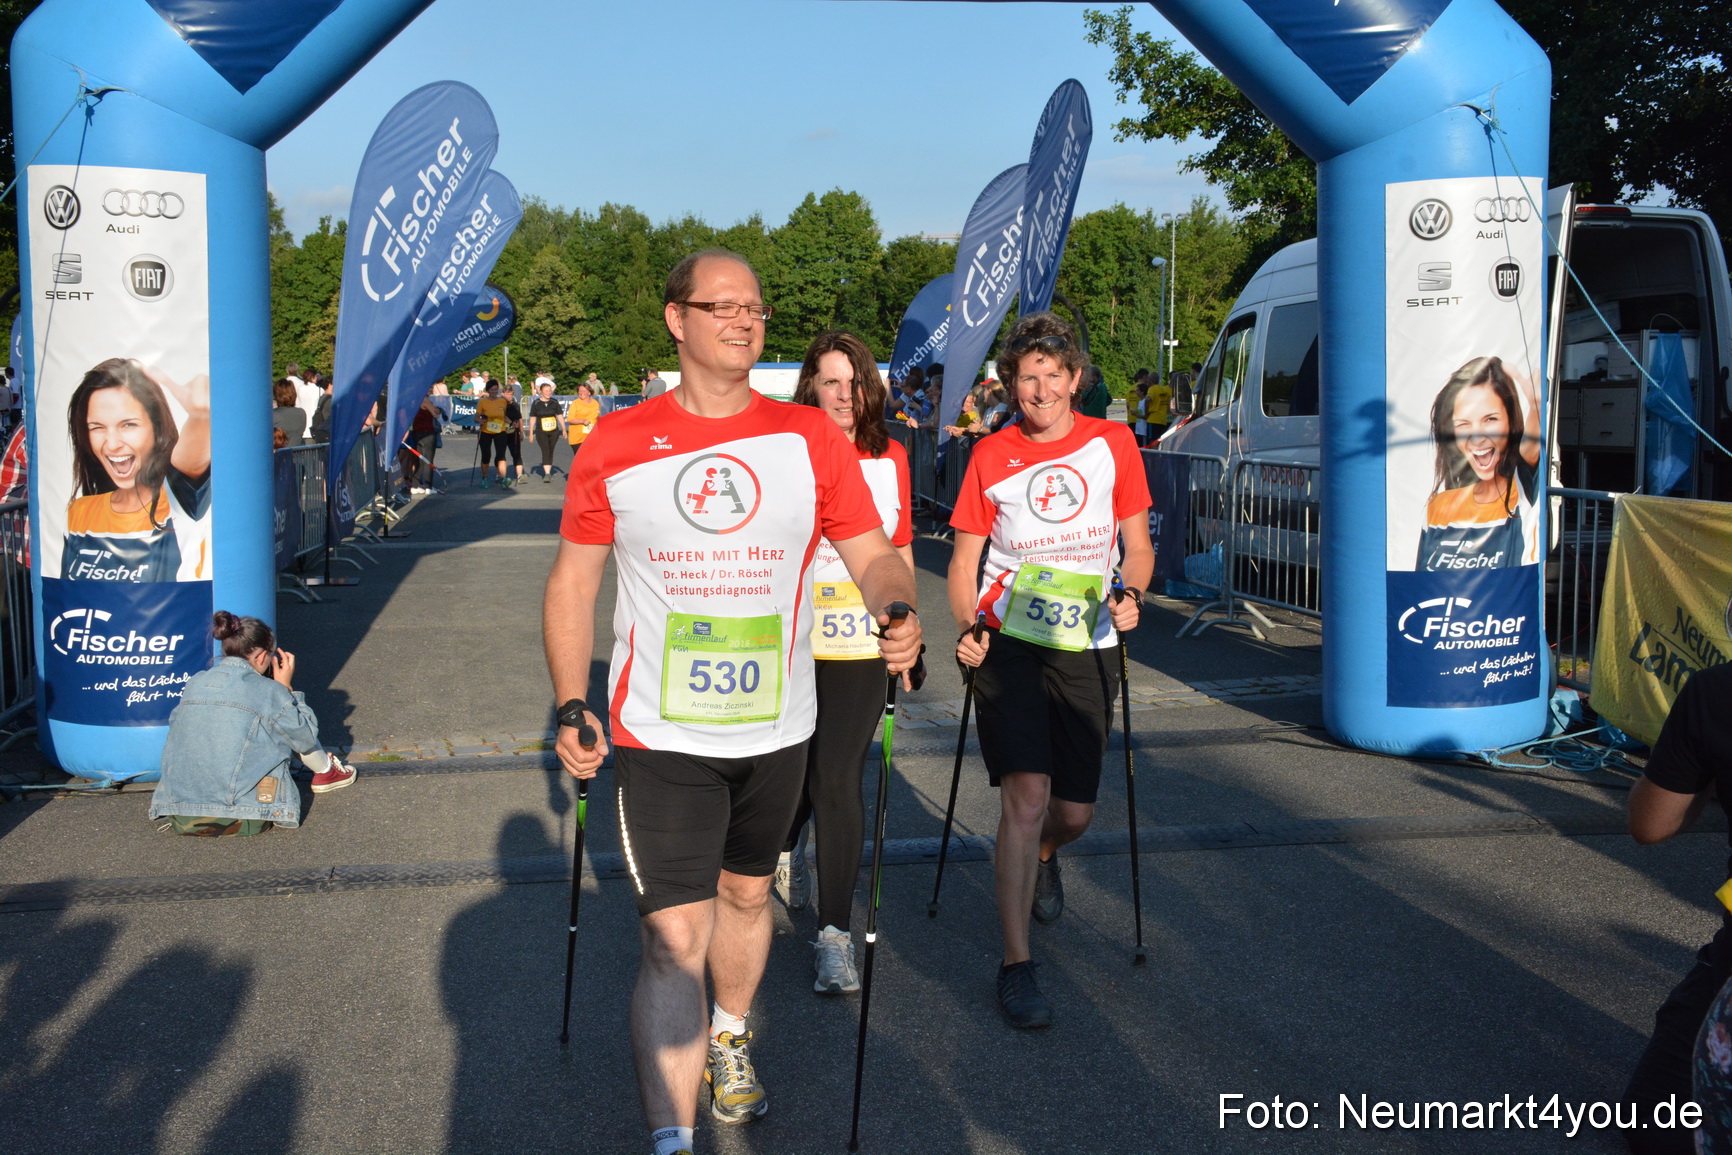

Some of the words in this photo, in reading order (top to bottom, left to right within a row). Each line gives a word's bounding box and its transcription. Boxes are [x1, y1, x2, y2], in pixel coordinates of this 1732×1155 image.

[382, 117, 463, 276] Fischer
[1036, 113, 1075, 276] Fischer
[411, 146, 473, 274] AUTOMOBILE
[1049, 140, 1081, 271] AUTOMOBILE
[106, 223, 140, 234] Audi
[1476, 230, 1503, 239] Audi
[449, 214, 501, 306] AUTOMOBILE
[976, 205, 1024, 308] Fische
[134, 267, 163, 289] FIAT
[1498, 269, 1518, 290] FIAT
[45, 290, 94, 301] SEAT
[1406, 296, 1464, 308] SEAT
[455, 338, 475, 352] Druck
[487, 318, 510, 335] Medien
[893, 316, 951, 383] Frischman
[663, 570, 678, 579] Dr.
[681, 569, 708, 579] Heck
[719, 569, 735, 579] Dr.
[738, 568, 773, 578] Röschl
[665, 584, 771, 598] Leistungsdiagnostik
[1026, 597, 1081, 628] 533
[822, 612, 871, 638] 531
[1031, 626, 1047, 634] Josef
[1423, 614, 1525, 637] Fischer
[67, 628, 184, 652] Fischer
[684, 632, 728, 643] firmenlauf
[1433, 636, 1520, 650] AUTOMOBILE
[76, 654, 174, 665] AUTOMOBILE
[1453, 661, 1477, 675] und
[1480, 658, 1501, 670] das
[94, 678, 119, 691] und
[122, 675, 147, 688] das
[688, 659, 760, 695] 530
[1483, 671, 1512, 688] fährt
[126, 690, 163, 707] fährt
[167, 687, 186, 698] mi
[691, 701, 722, 709] Andreas
[724, 701, 754, 710] Ziczinski
